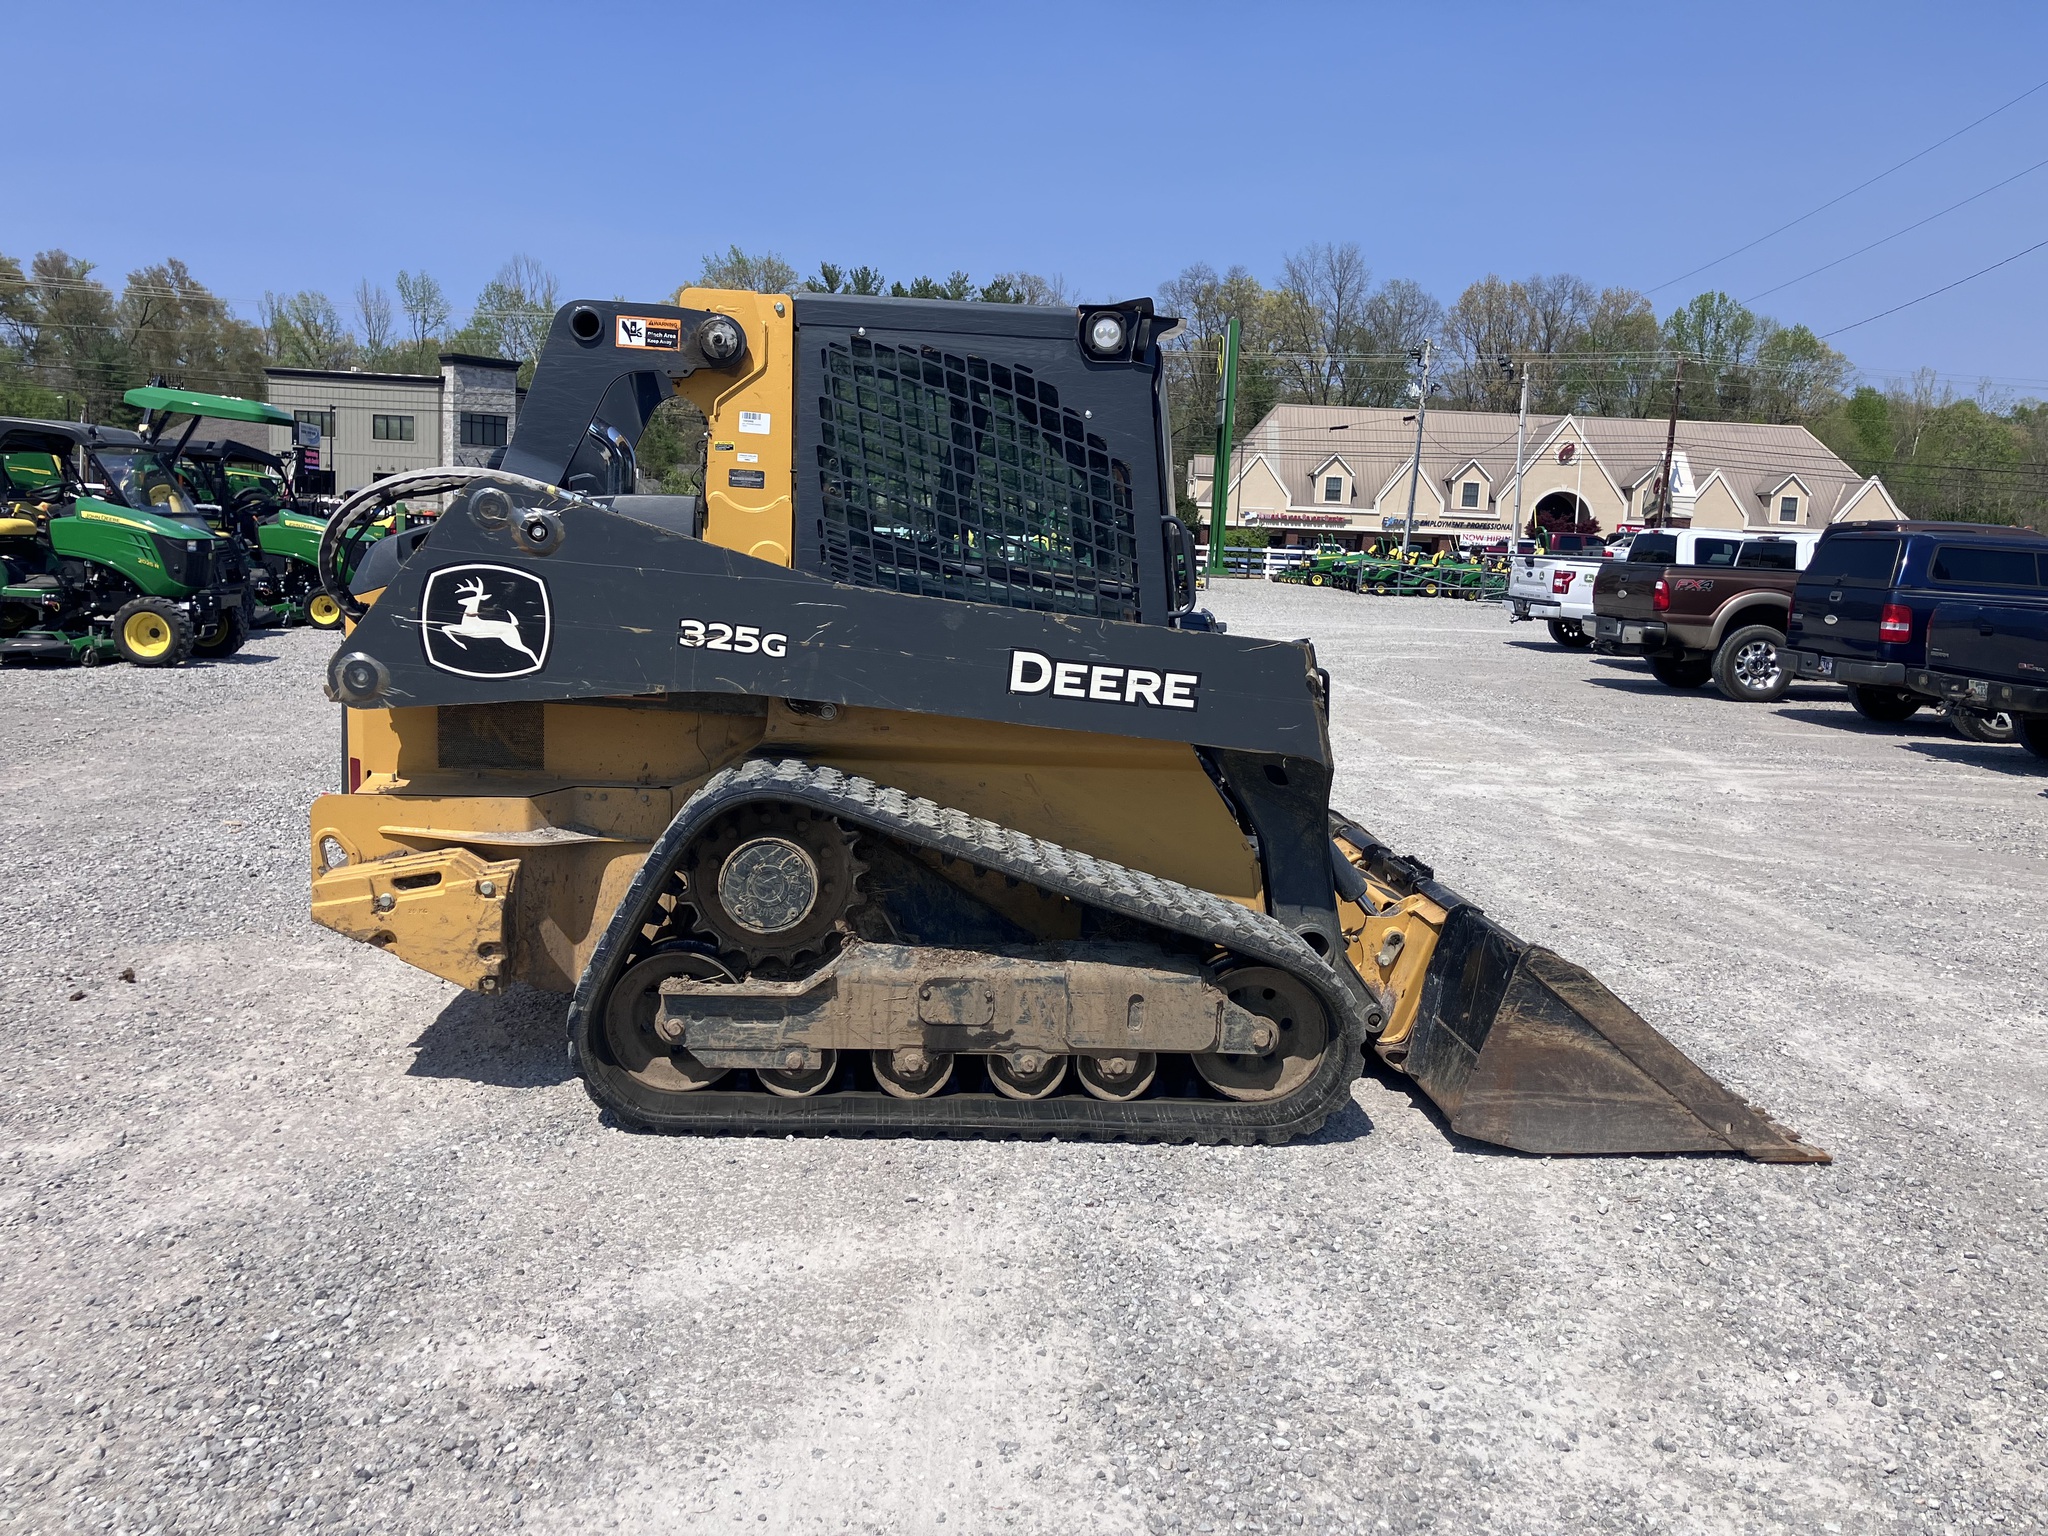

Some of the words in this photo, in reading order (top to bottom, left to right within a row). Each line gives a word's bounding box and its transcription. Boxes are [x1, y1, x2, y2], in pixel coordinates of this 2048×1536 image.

[1420, 519, 1464, 528] EMPLOYMENT
[1466, 521, 1514, 531] PROFESSIONAL
[1462, 533, 1485, 541] NOW
[1675, 578, 1714, 589] FX4
[679, 619, 788, 658] 325G
[1010, 650, 1198, 708] DEERE
